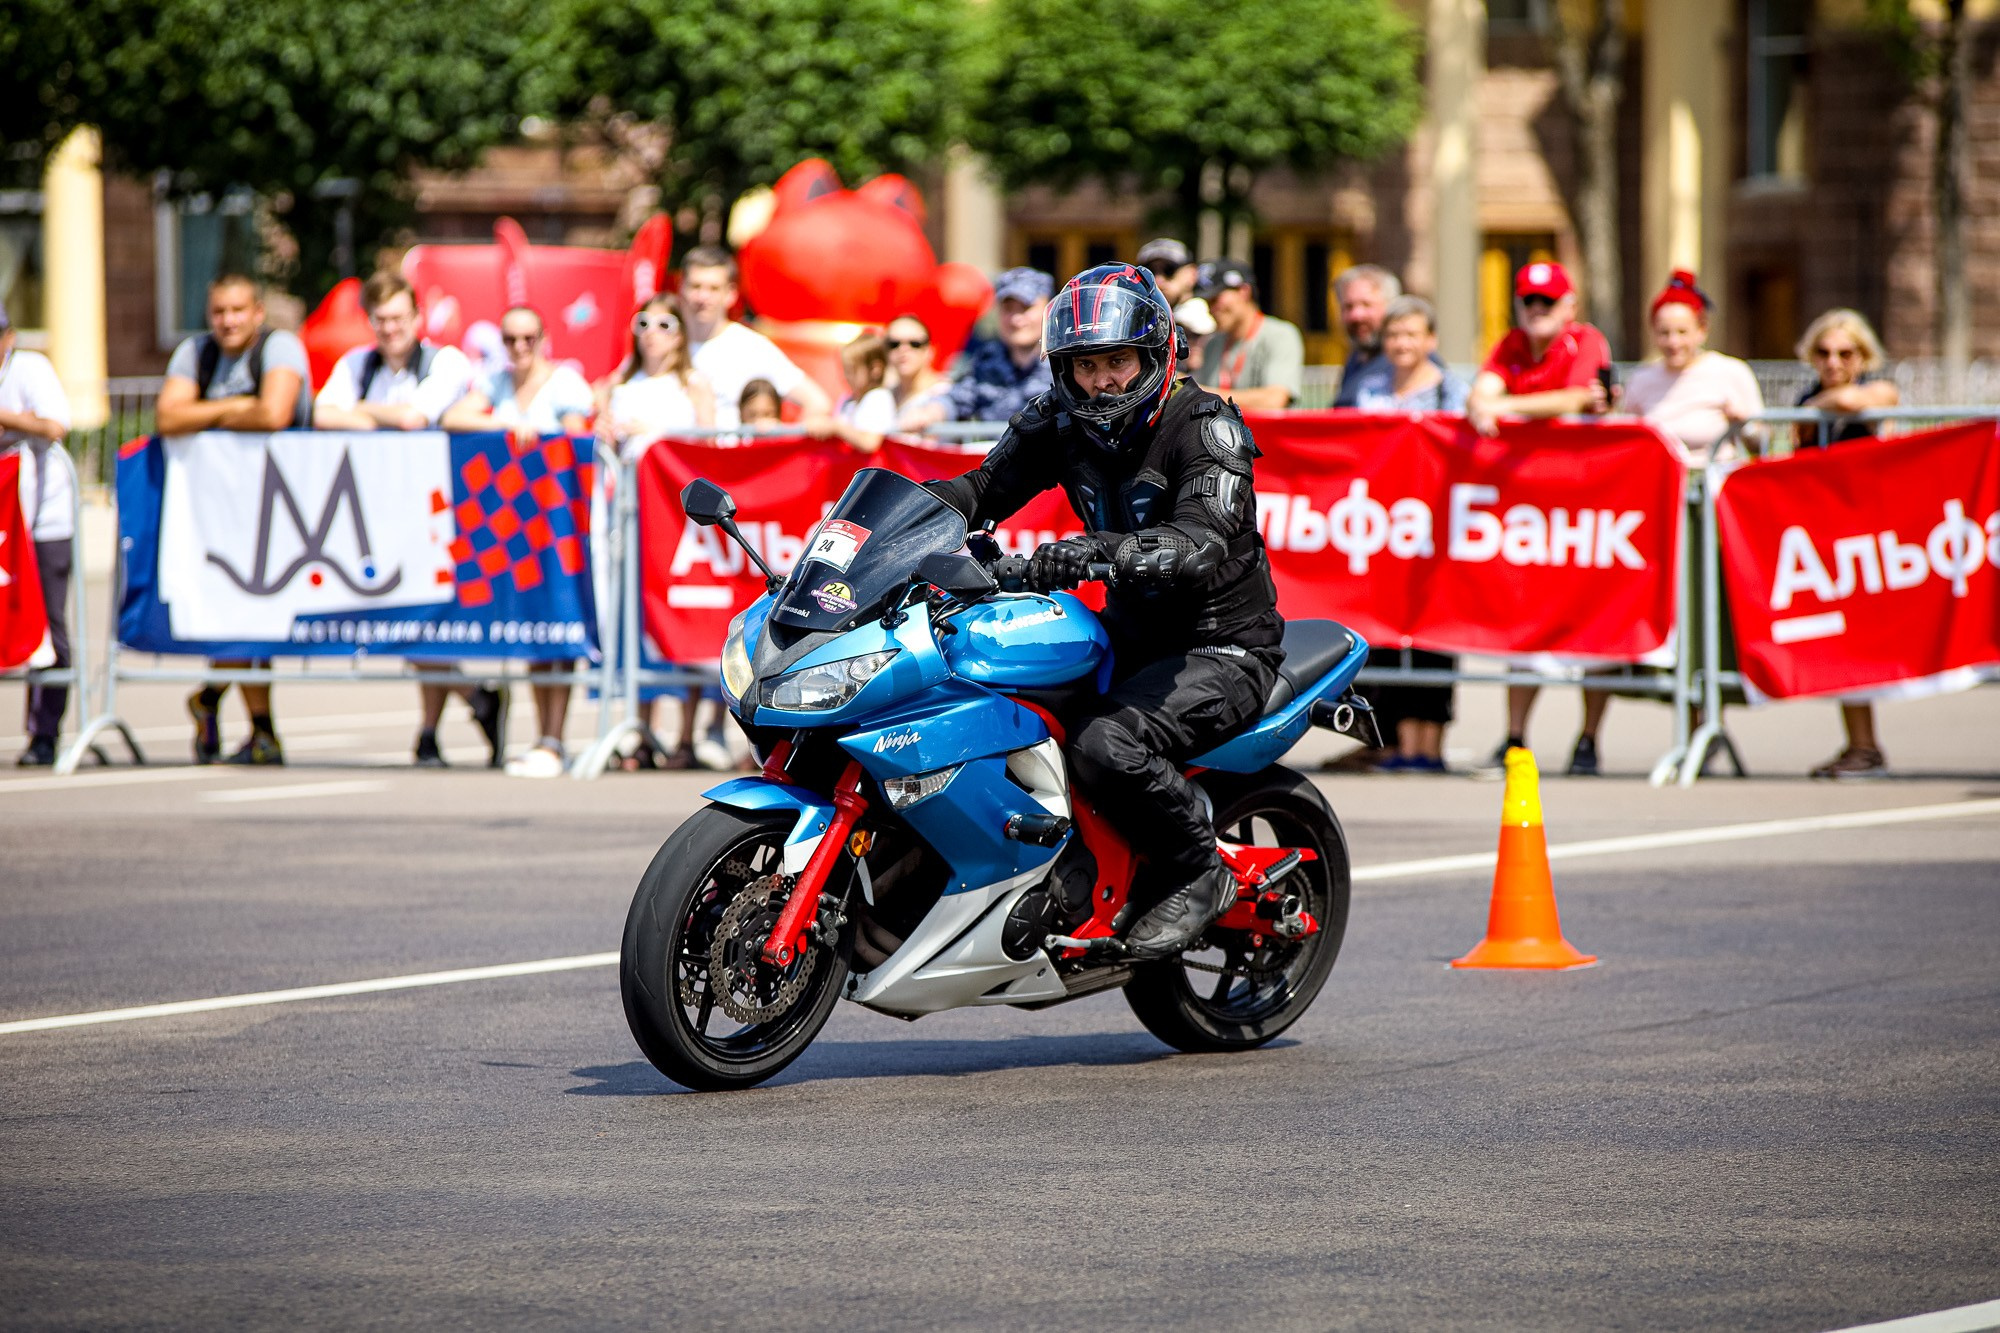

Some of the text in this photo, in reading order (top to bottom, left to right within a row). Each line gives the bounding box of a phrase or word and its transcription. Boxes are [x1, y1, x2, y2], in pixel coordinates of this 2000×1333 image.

[1065, 321, 1112, 334] LS2
[1255, 478, 1647, 575] льфа Банк
[669, 501, 835, 577] Аль
[817, 539, 835, 552] 24
[825, 583, 845, 596] 24
[779, 604, 810, 618] Kawasaki
[489, 620, 586, 644] РОССИИ
[873, 728, 922, 753] Ninja
